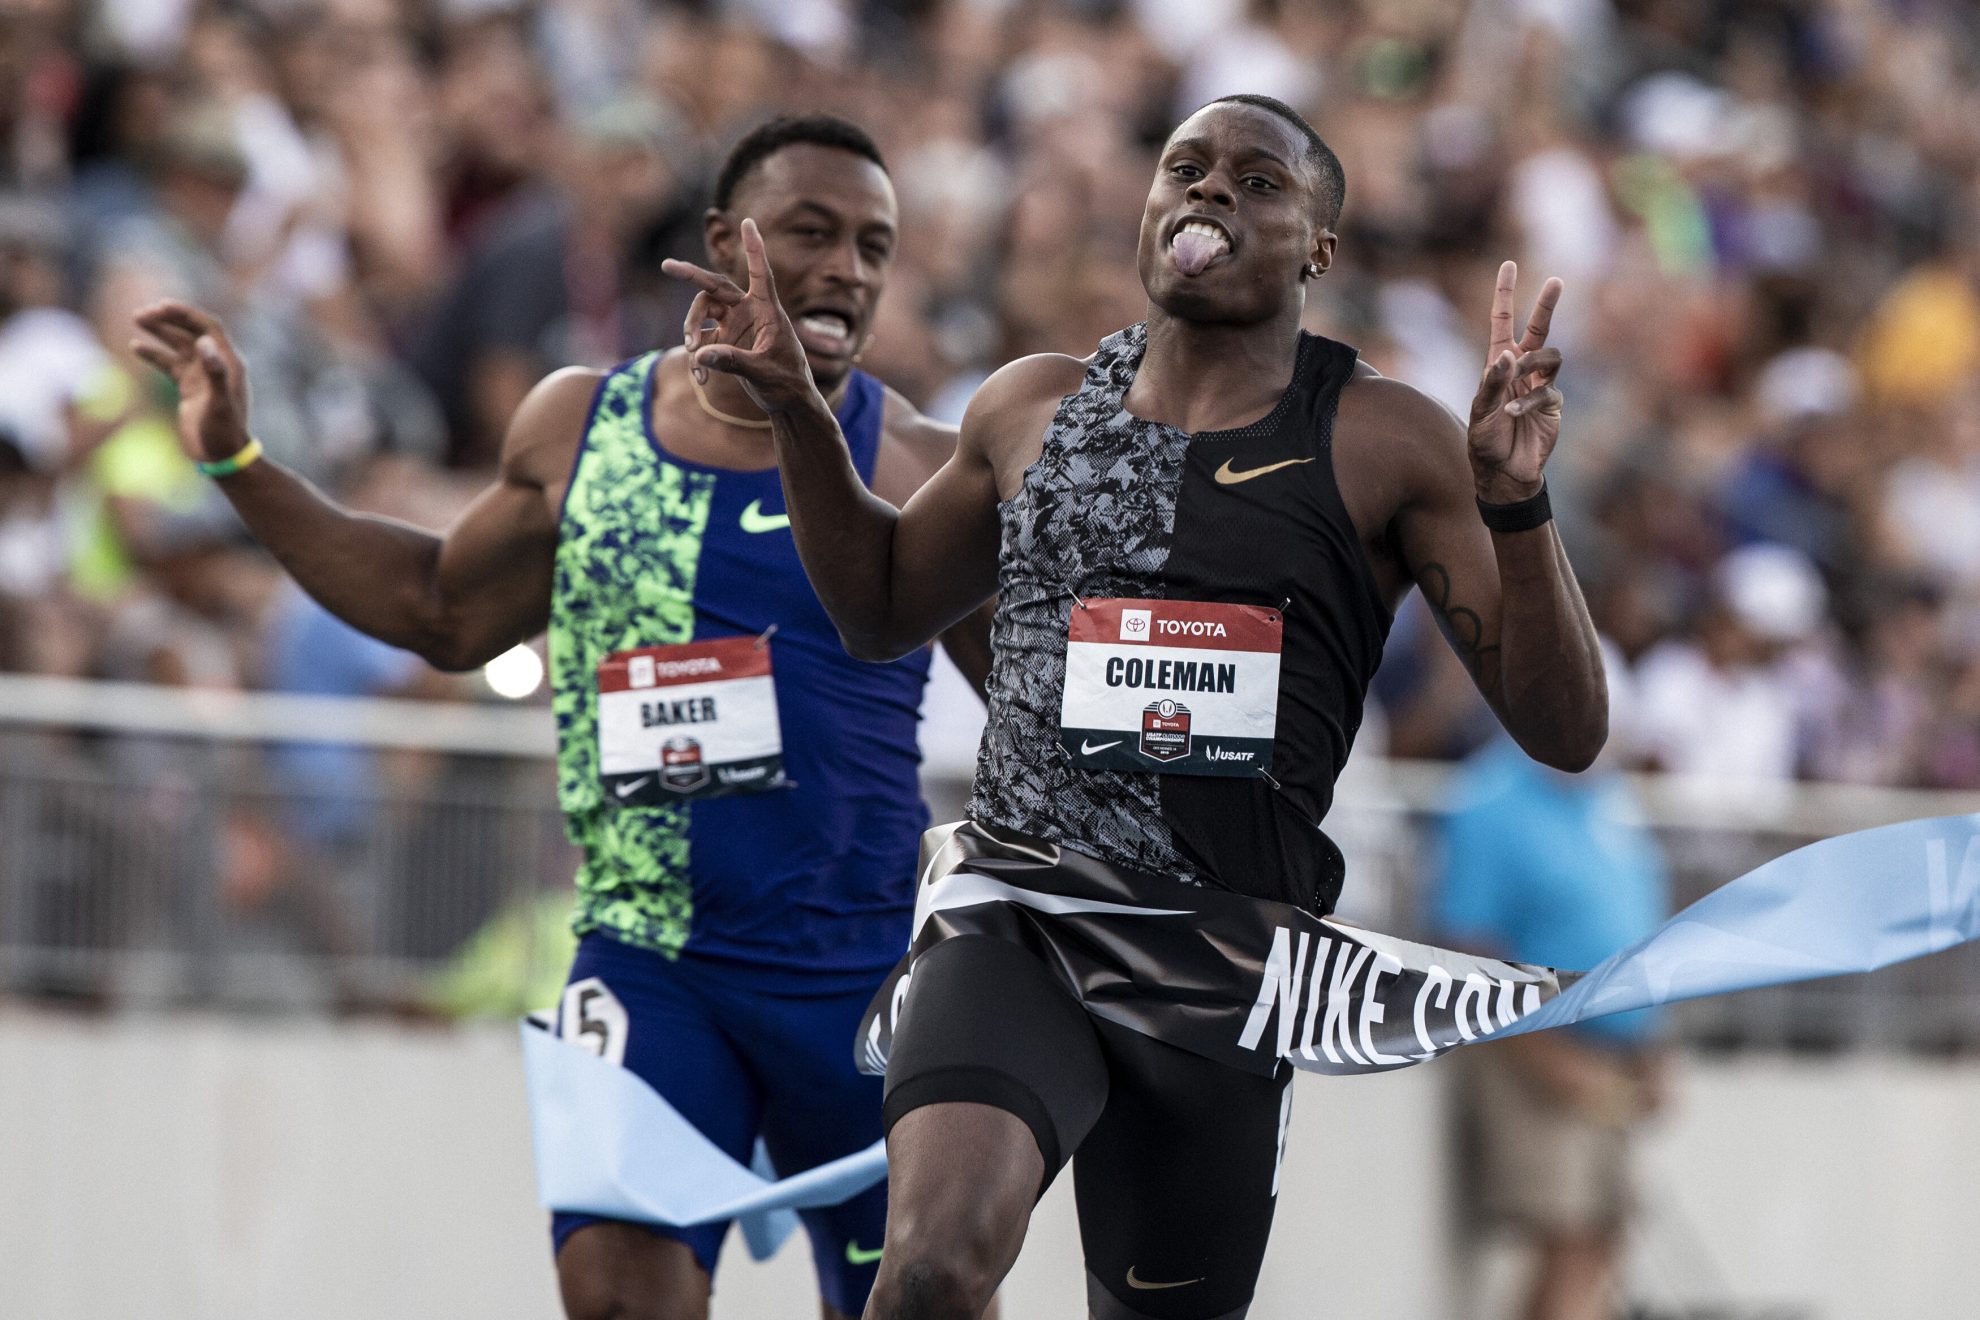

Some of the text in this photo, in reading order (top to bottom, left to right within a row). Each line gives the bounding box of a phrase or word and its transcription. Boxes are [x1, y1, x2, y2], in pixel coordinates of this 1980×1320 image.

[1157, 619, 1227, 638] TOYOTA
[1105, 656, 1236, 694] COLEMAN
[641, 696, 717, 729] BAKER
[1220, 751, 1255, 761] USATF
[579, 987, 609, 1057] 5
